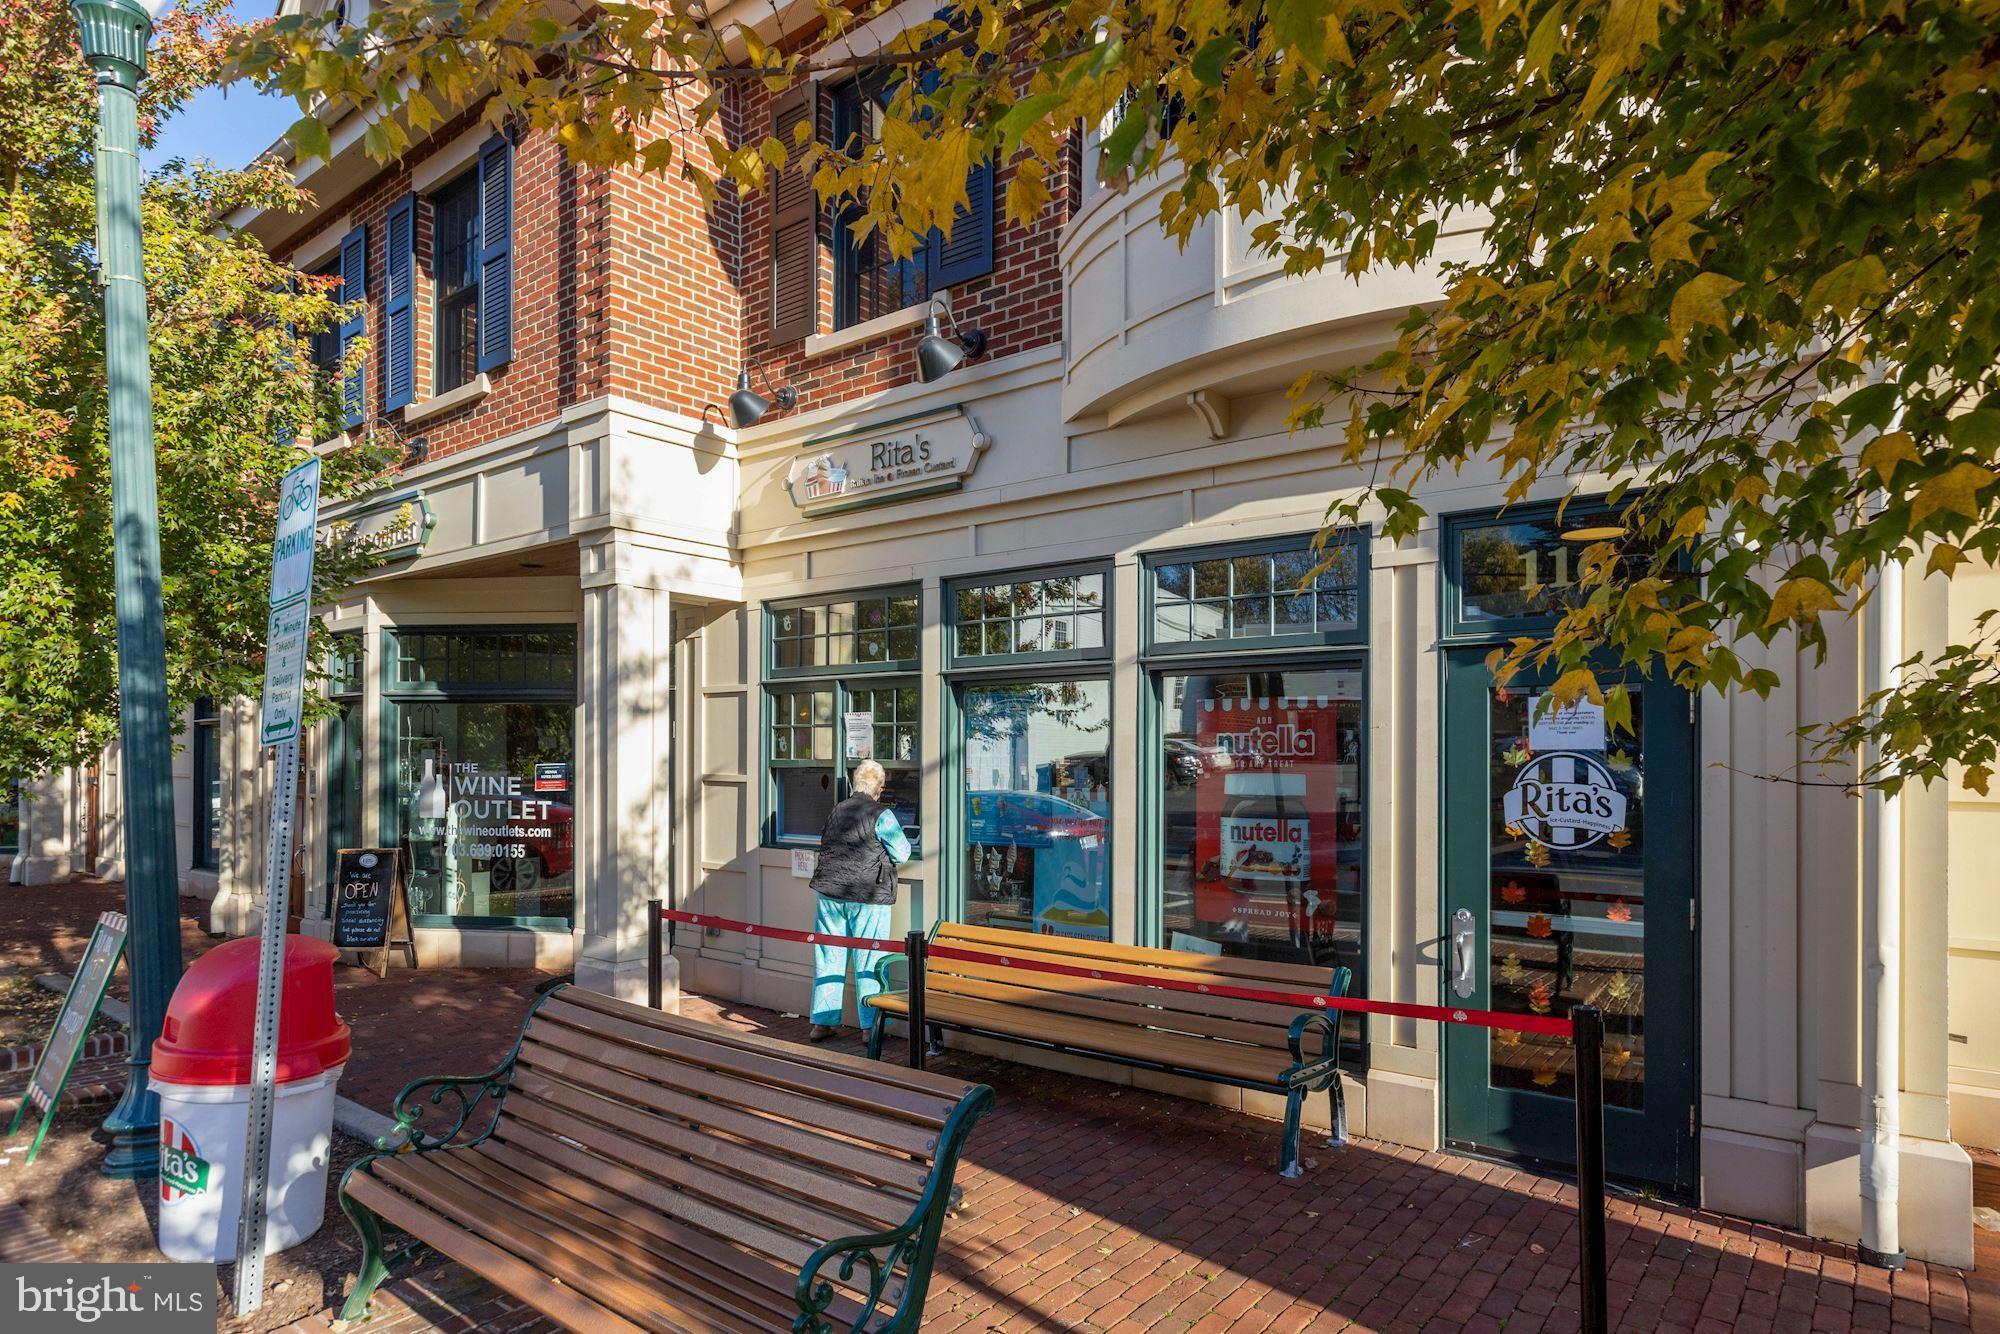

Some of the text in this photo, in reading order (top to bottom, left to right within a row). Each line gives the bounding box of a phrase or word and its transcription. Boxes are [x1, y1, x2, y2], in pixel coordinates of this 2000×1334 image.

[870, 433, 931, 471] Rita's
[275, 525, 312, 562] PARKING
[273, 618, 302, 638] 5 Minute
[275, 639, 296, 653] Takeout
[272, 673, 293, 688] Delivery
[271, 690, 292, 704] Parking
[274, 708, 287, 721] Only
[1216, 723, 1315, 756] nutella
[454, 763, 479, 773] THE
[1268, 759, 1296, 768] TREAT
[454, 776, 522, 796] WINE
[455, 799, 553, 820] OUTLET
[1521, 783, 1613, 818] Rita's
[1231, 817, 1302, 843] nutella
[1549, 817, 1611, 831] Ice-Custard-Happiness
[444, 844, 526, 859] 703.639.0155
[345, 882, 379, 900] OPEN
[1237, 907, 1291, 918] SPREAD JOY
[160, 1144, 199, 1184] ita's
